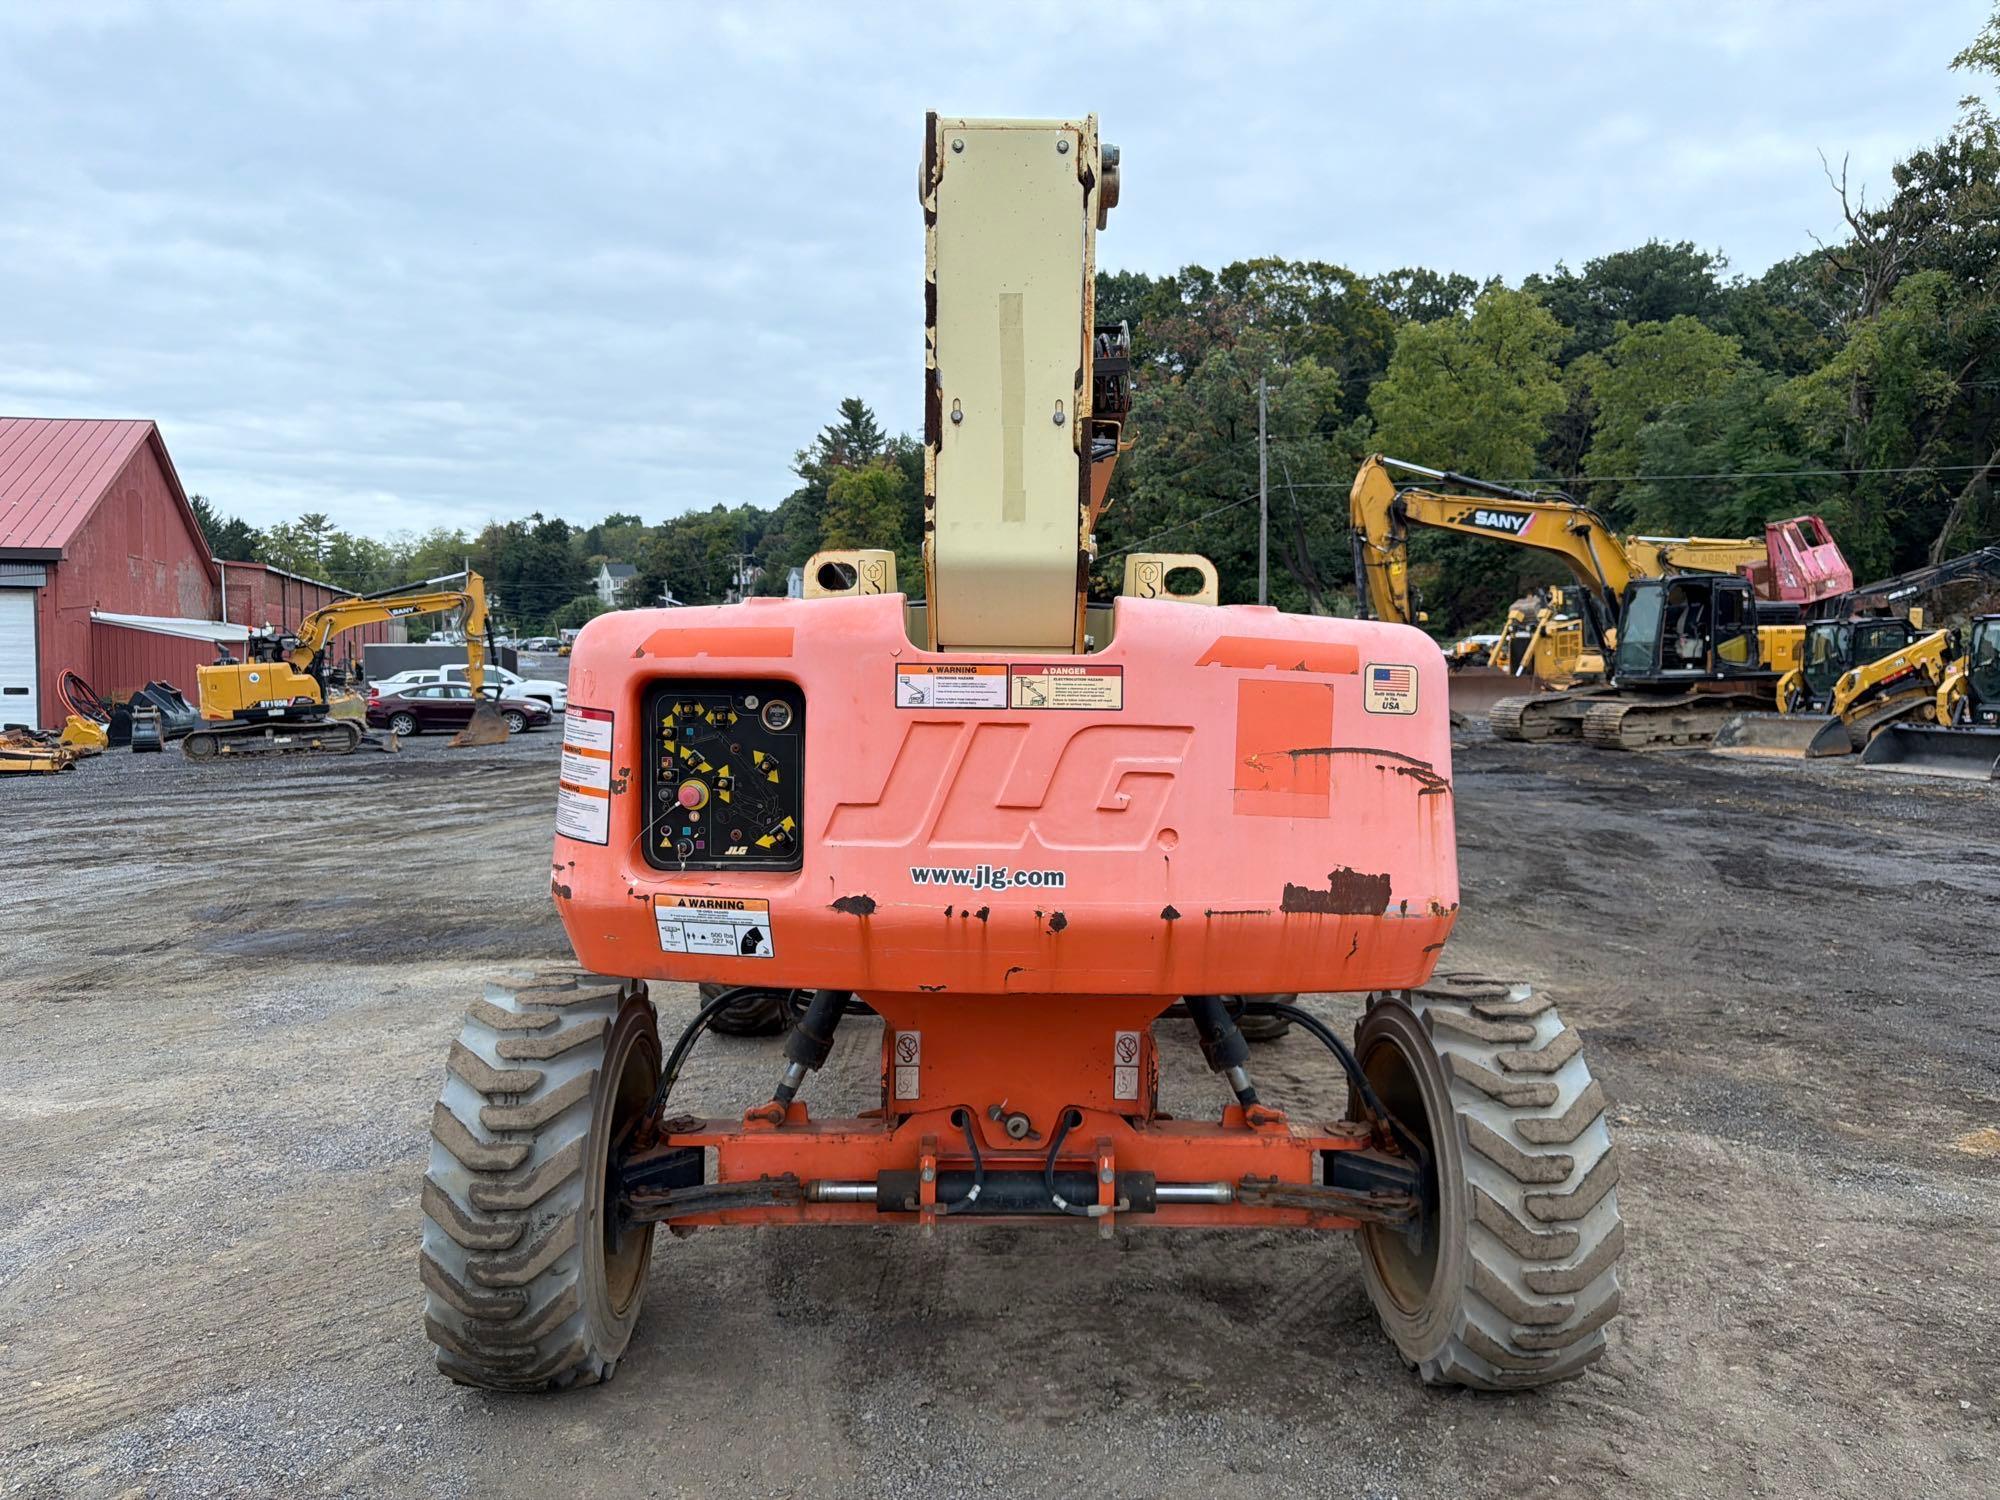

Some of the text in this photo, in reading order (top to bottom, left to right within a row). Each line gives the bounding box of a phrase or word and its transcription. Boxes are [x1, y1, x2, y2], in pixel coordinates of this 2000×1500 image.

[1475, 511, 1524, 530] SANY
[392, 606, 414, 615] SANY
[936, 666, 977, 674] WARNING
[1050, 667, 1086, 675] DANGER
[1382, 702, 1400, 710] USA
[822, 720, 1196, 852] JLG
[724, 845, 749, 856] JLG
[911, 865, 1065, 889] www.jlg.com
[688, 898, 745, 910] WARNING
[726, 938, 734, 946] kg
